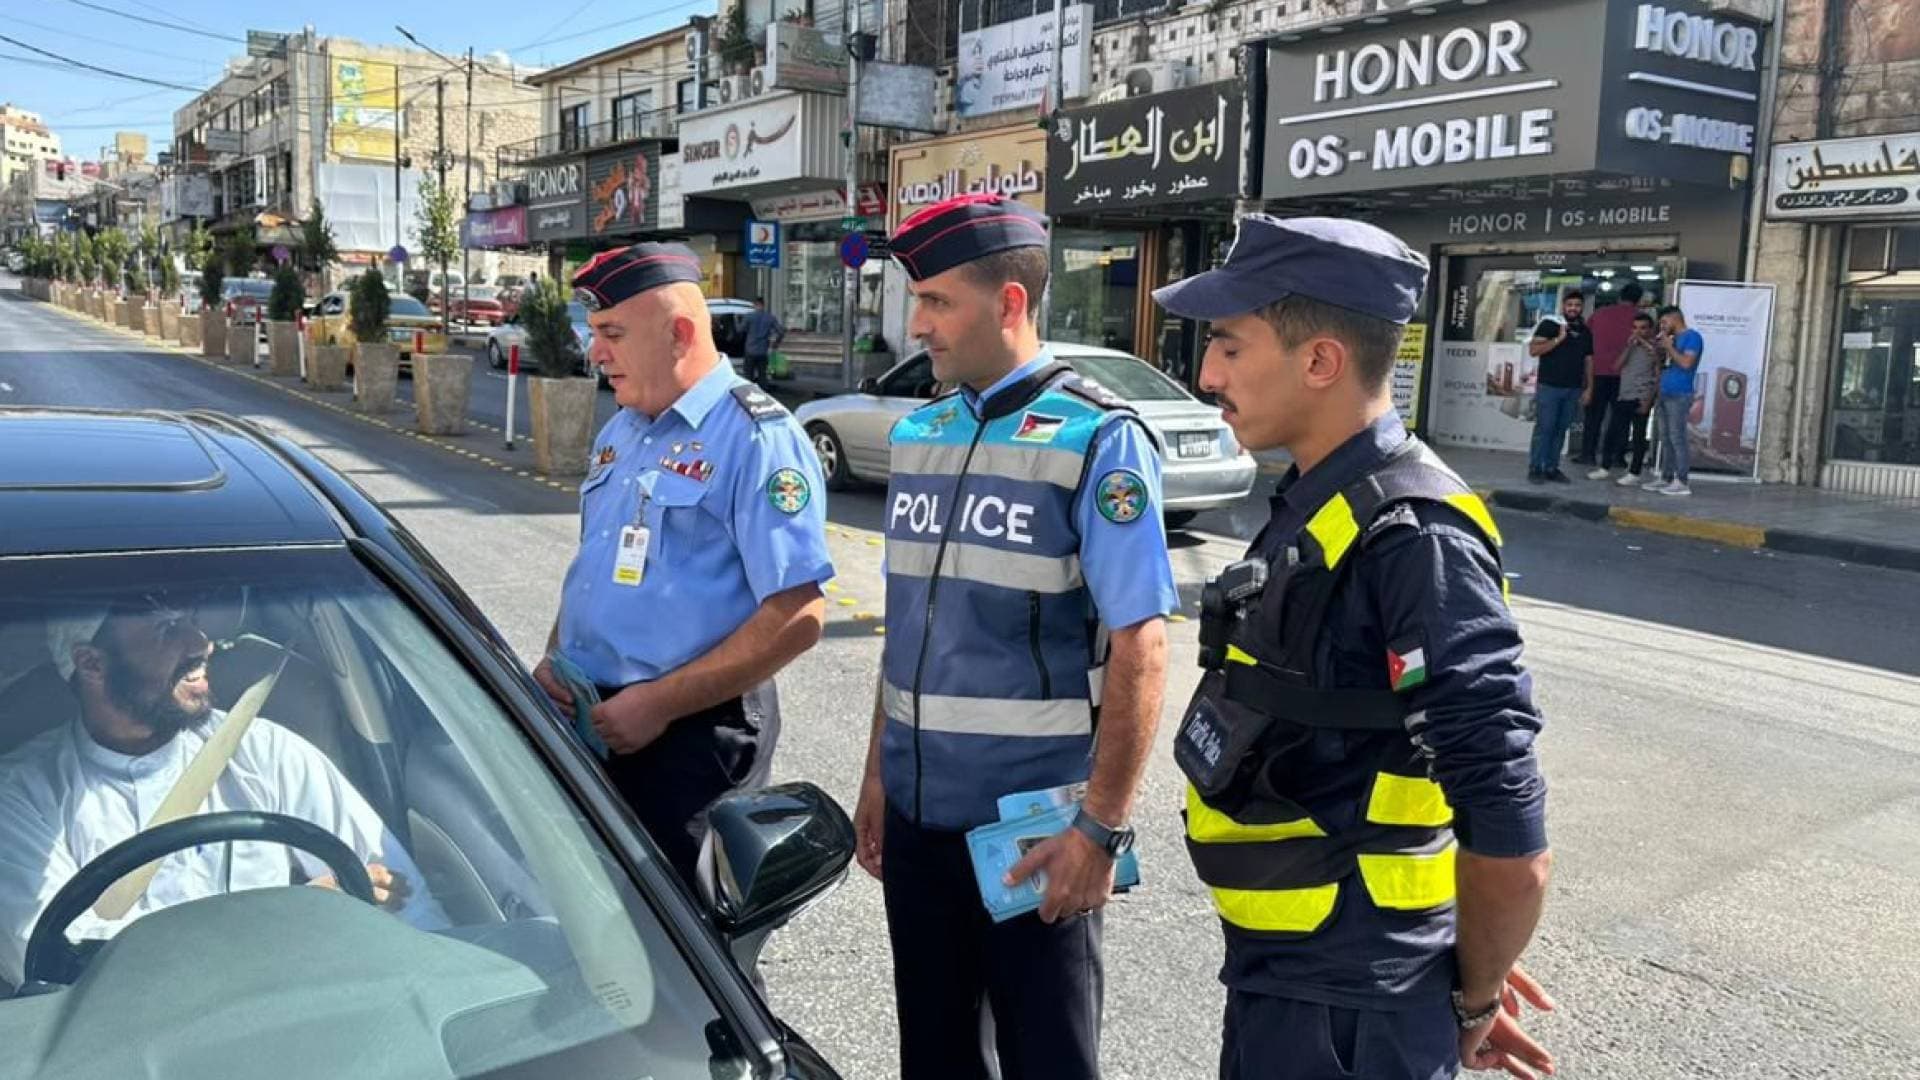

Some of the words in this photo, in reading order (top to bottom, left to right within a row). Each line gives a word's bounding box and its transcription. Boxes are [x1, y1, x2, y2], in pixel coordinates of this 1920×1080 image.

[1635, 4, 1757, 71] HONOR
[1314, 20, 1527, 102] HONOR
[1064, 106, 1165, 181] العطار
[1169, 95, 1228, 163] ابن
[683, 140, 721, 164] SINGER
[529, 164, 579, 198] HONOR
[966, 160, 1038, 200] حلويات
[1073, 184, 1112, 204] مباخر
[1122, 179, 1157, 200] بخور
[1167, 174, 1209, 195] عطور
[1449, 212, 1527, 235] HONOR
[890, 491, 1035, 544] POLICE
